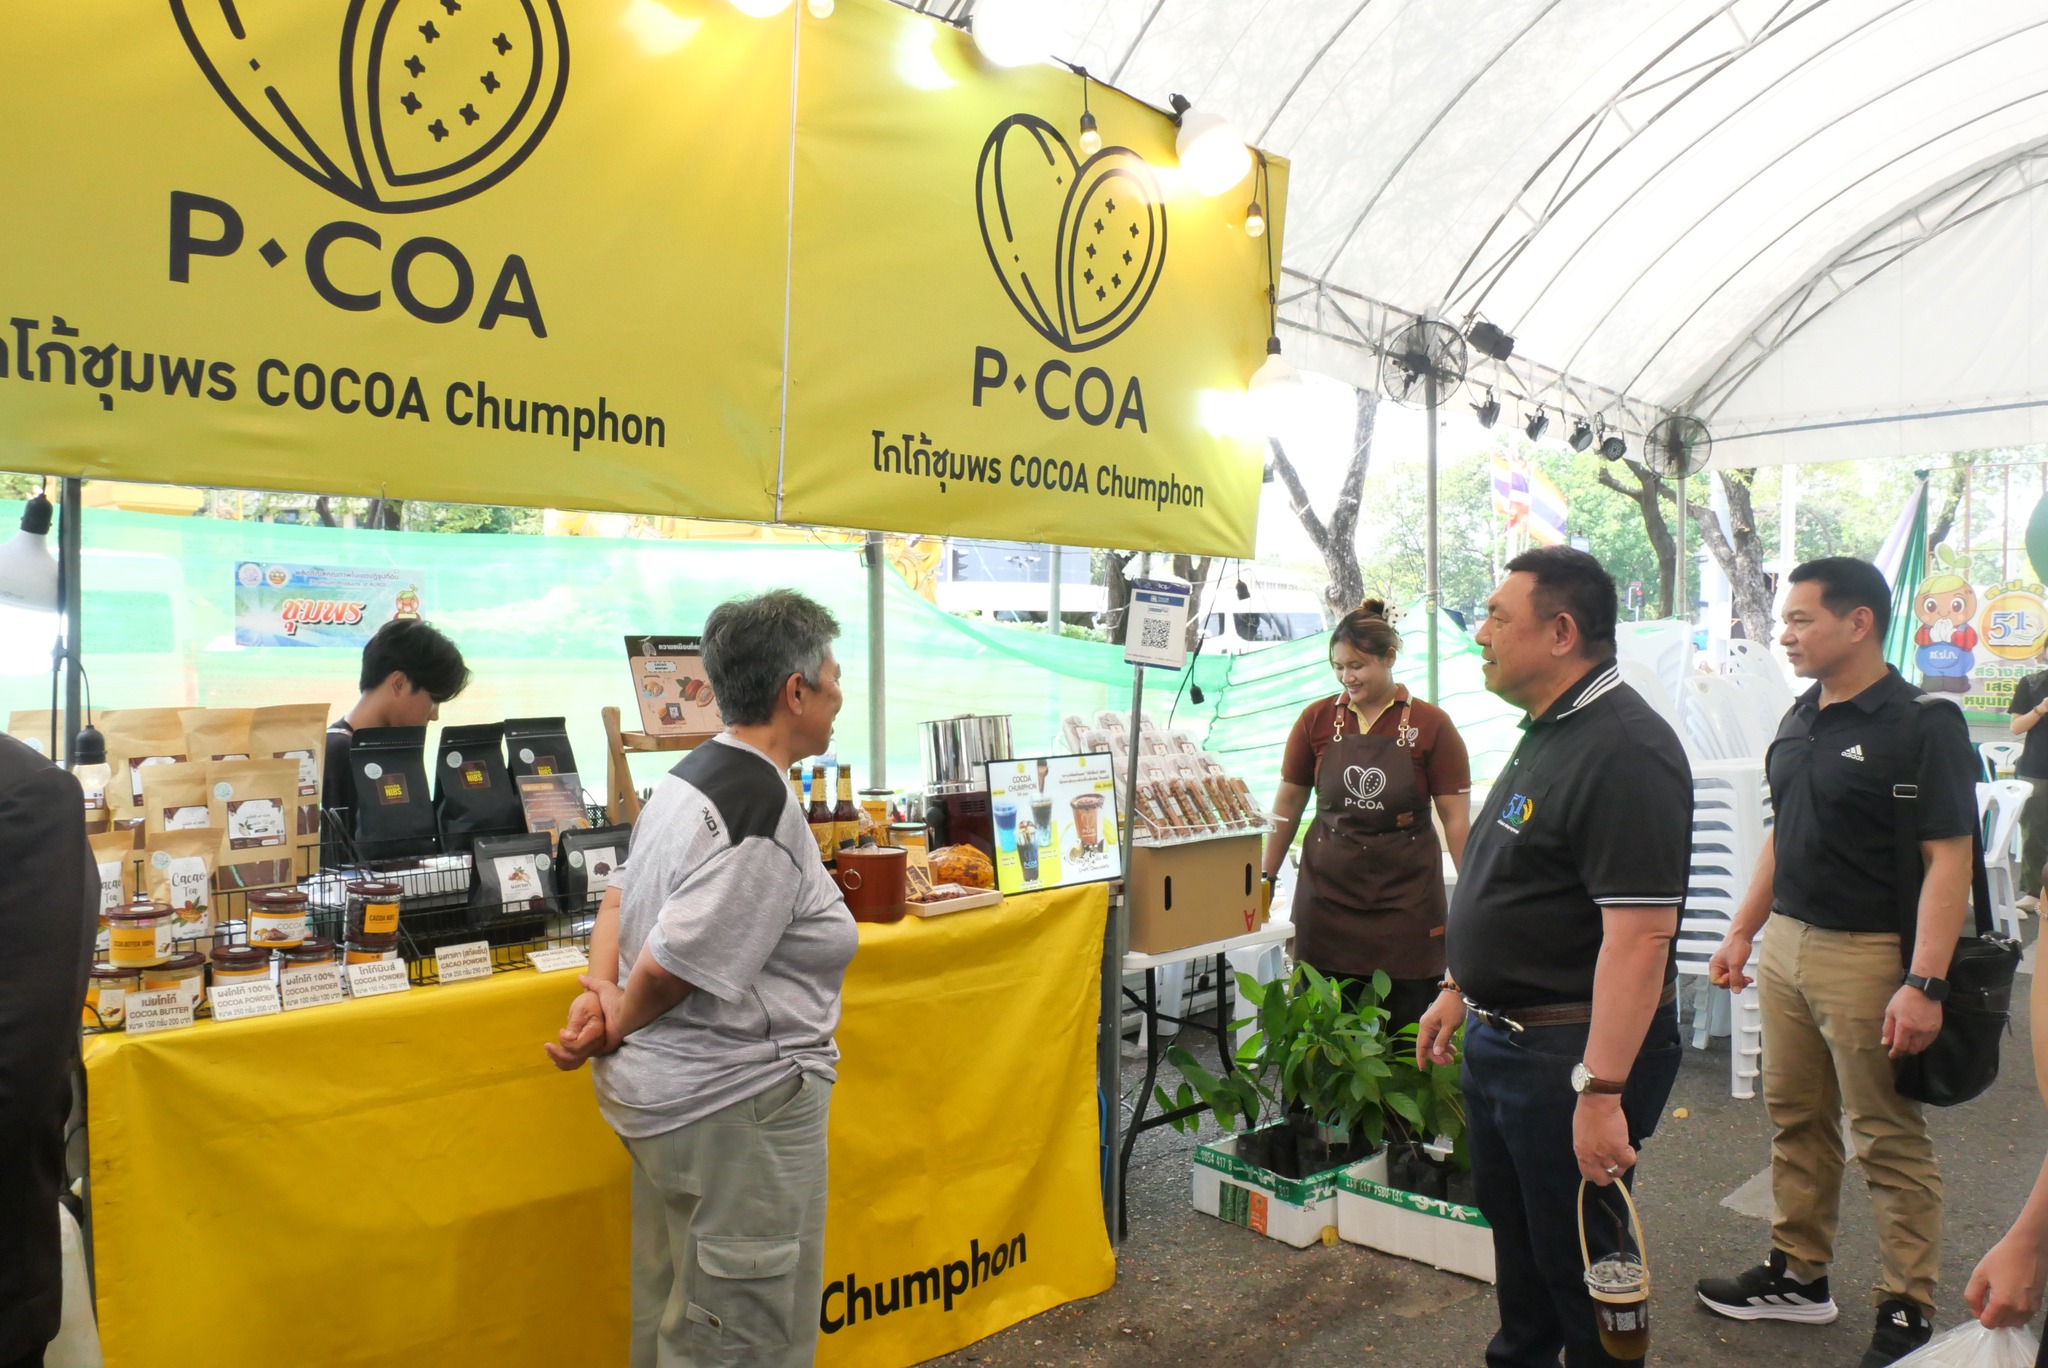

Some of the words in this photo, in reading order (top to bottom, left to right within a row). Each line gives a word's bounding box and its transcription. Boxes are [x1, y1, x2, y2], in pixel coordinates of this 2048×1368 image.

[0, 316, 237, 411] โก้ชุมพร
[257, 358, 430, 422] COCOA
[445, 381, 666, 452] Chumphon
[872, 430, 1001, 493] โกโก้ชุมพร
[1010, 454, 1089, 493] COCOA
[1096, 464, 1204, 511] Chumphon
[282, 598, 365, 633] ชุมพร
[1990, 611, 2026, 639] 51
[1012, 775, 1032, 783] COCOA
[386, 788, 402, 797] NIBS
[172, 872, 206, 887] Cacao
[104, 893, 117, 903] Tea
[183, 886, 198, 897] Tea
[276, 921, 302, 930] COCOA
[440, 960, 462, 969] CACAO
[462, 956, 488, 966] POWDER
[286, 973, 312, 985] ผงโกโก้
[314, 972, 335, 981] 100%
[354, 978, 377, 986] COCOA
[378, 972, 405, 983] POWDER
[218, 986, 246, 998] ผงโกโก้
[248, 984, 272, 994] 100%
[285, 987, 309, 996] COCOA
[310, 982, 338, 992] POWDER
[142, 993, 177, 1007] เนยโกโก้
[218, 999, 244, 1008] COCOA
[245, 994, 275, 1006] POWDER
[130, 1010, 159, 1019] COCOA
[160, 1006, 189, 1016] BUTTER
[145, 1020, 156, 1028] 150
[168, 1018, 180, 1026] 200
[820, 1232, 1026, 1334] Chumphon
